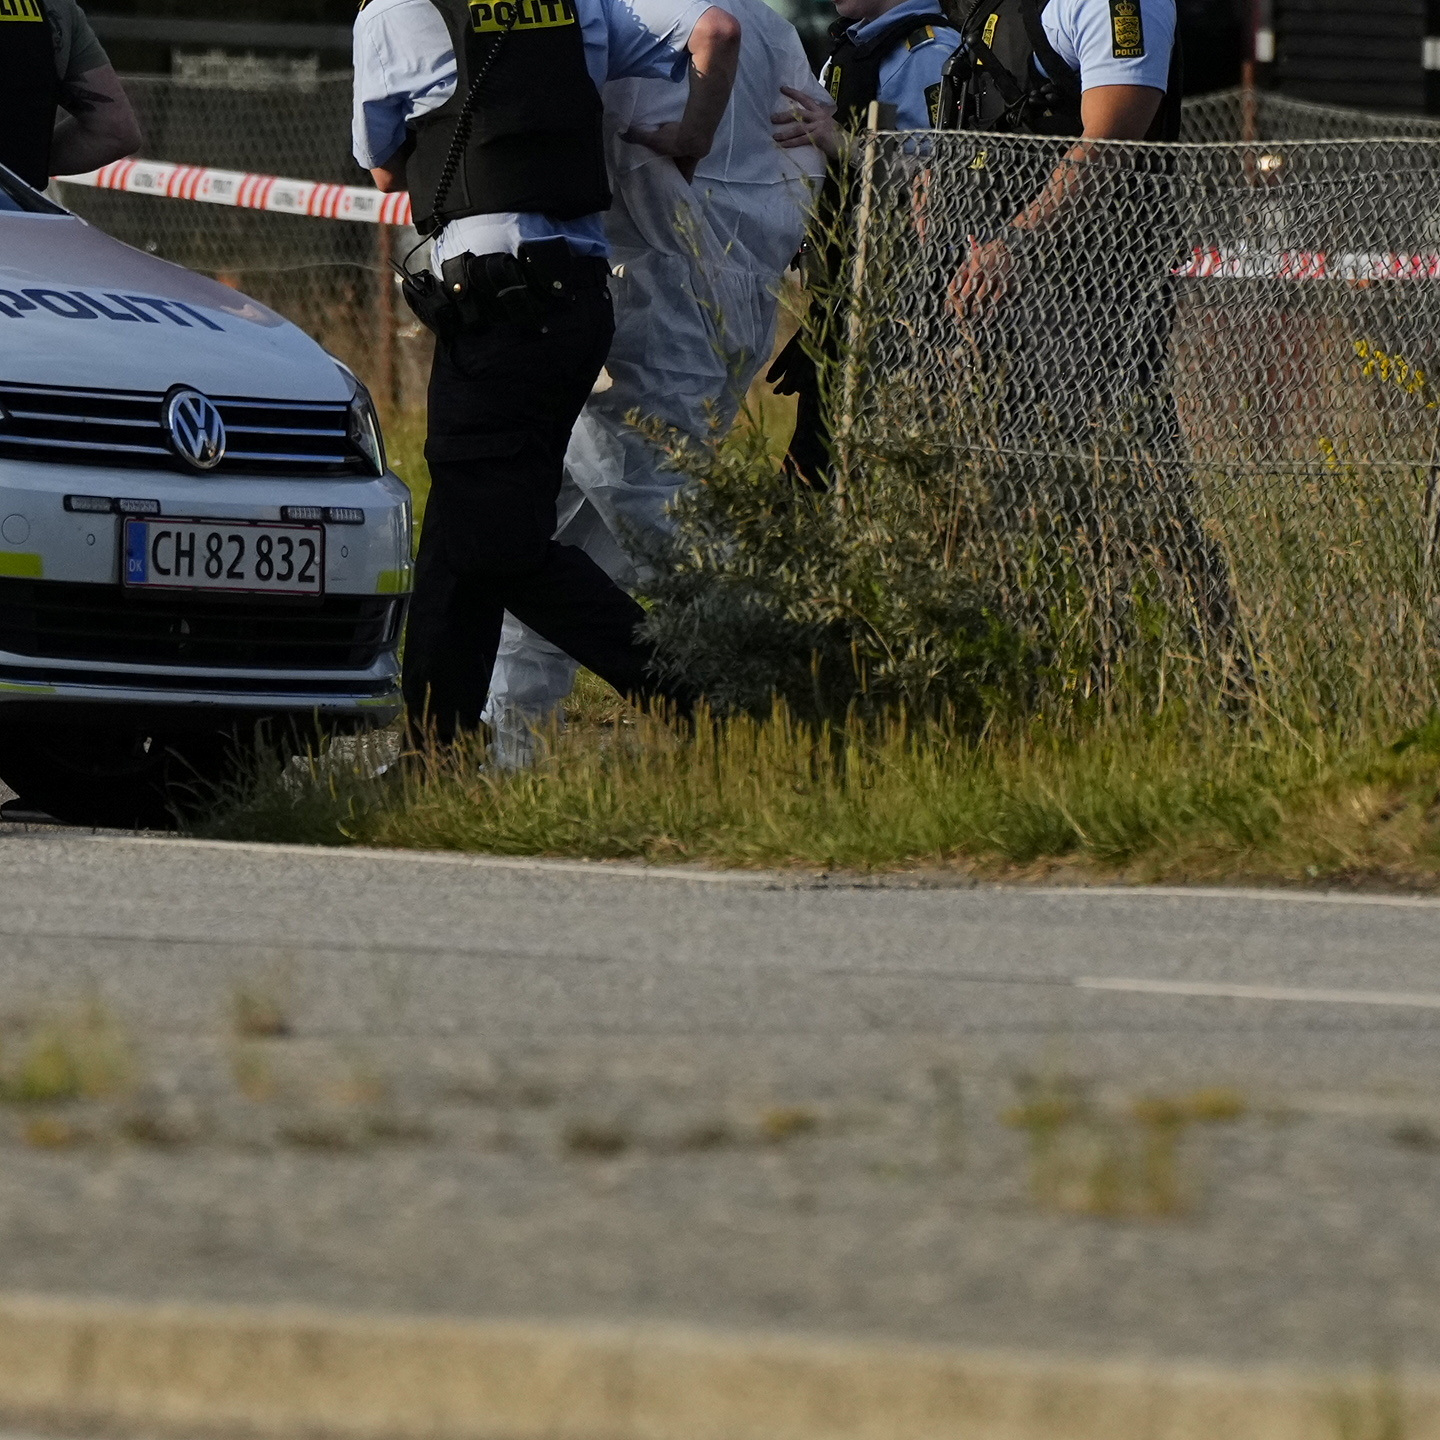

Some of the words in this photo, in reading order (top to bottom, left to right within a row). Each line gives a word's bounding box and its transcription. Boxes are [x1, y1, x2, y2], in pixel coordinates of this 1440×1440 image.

[129, 559, 143, 573] DK
[152, 530, 196, 577] CH
[205, 532, 245, 580] 82
[255, 534, 316, 584] 832
